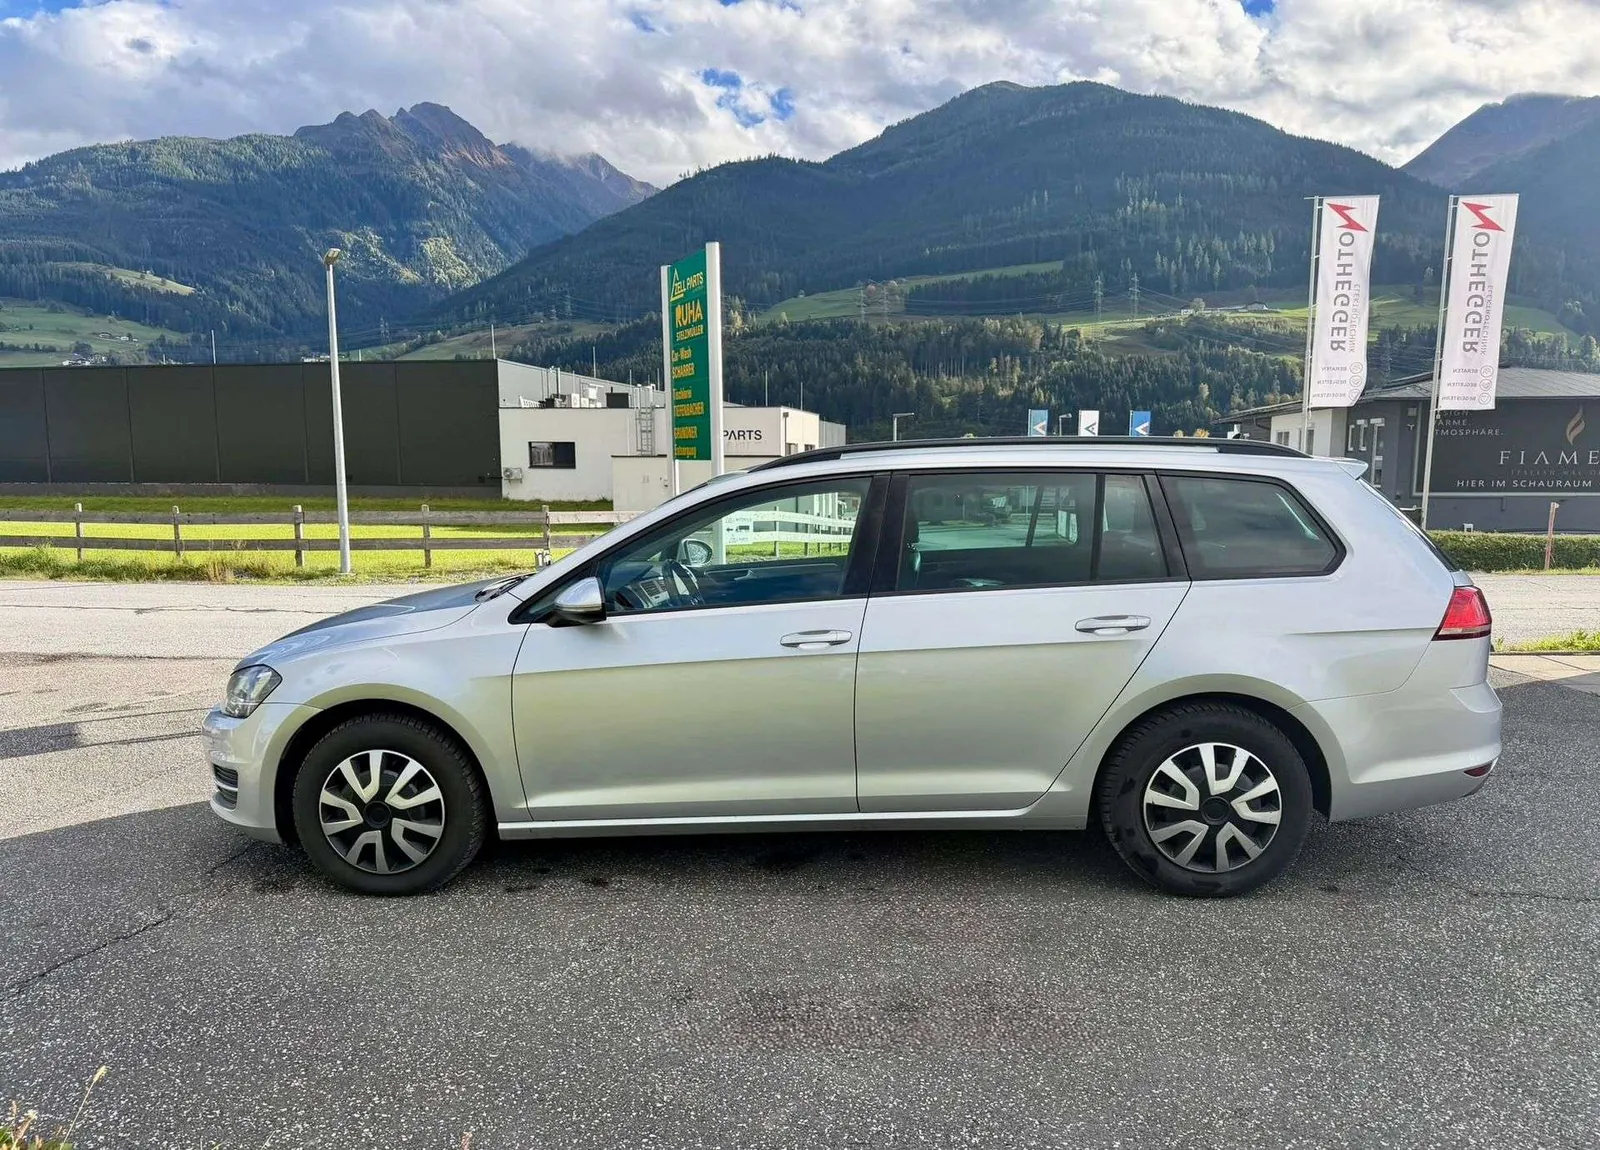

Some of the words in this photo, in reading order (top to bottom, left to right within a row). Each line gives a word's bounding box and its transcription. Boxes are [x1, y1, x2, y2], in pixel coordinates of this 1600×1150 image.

[675, 298, 704, 329] RUHA
[723, 430, 762, 440] PARTS
[1456, 479, 1485, 488] HIER
[1491, 479, 1506, 488] IM
[1512, 479, 1593, 488] SCHAURAUM
